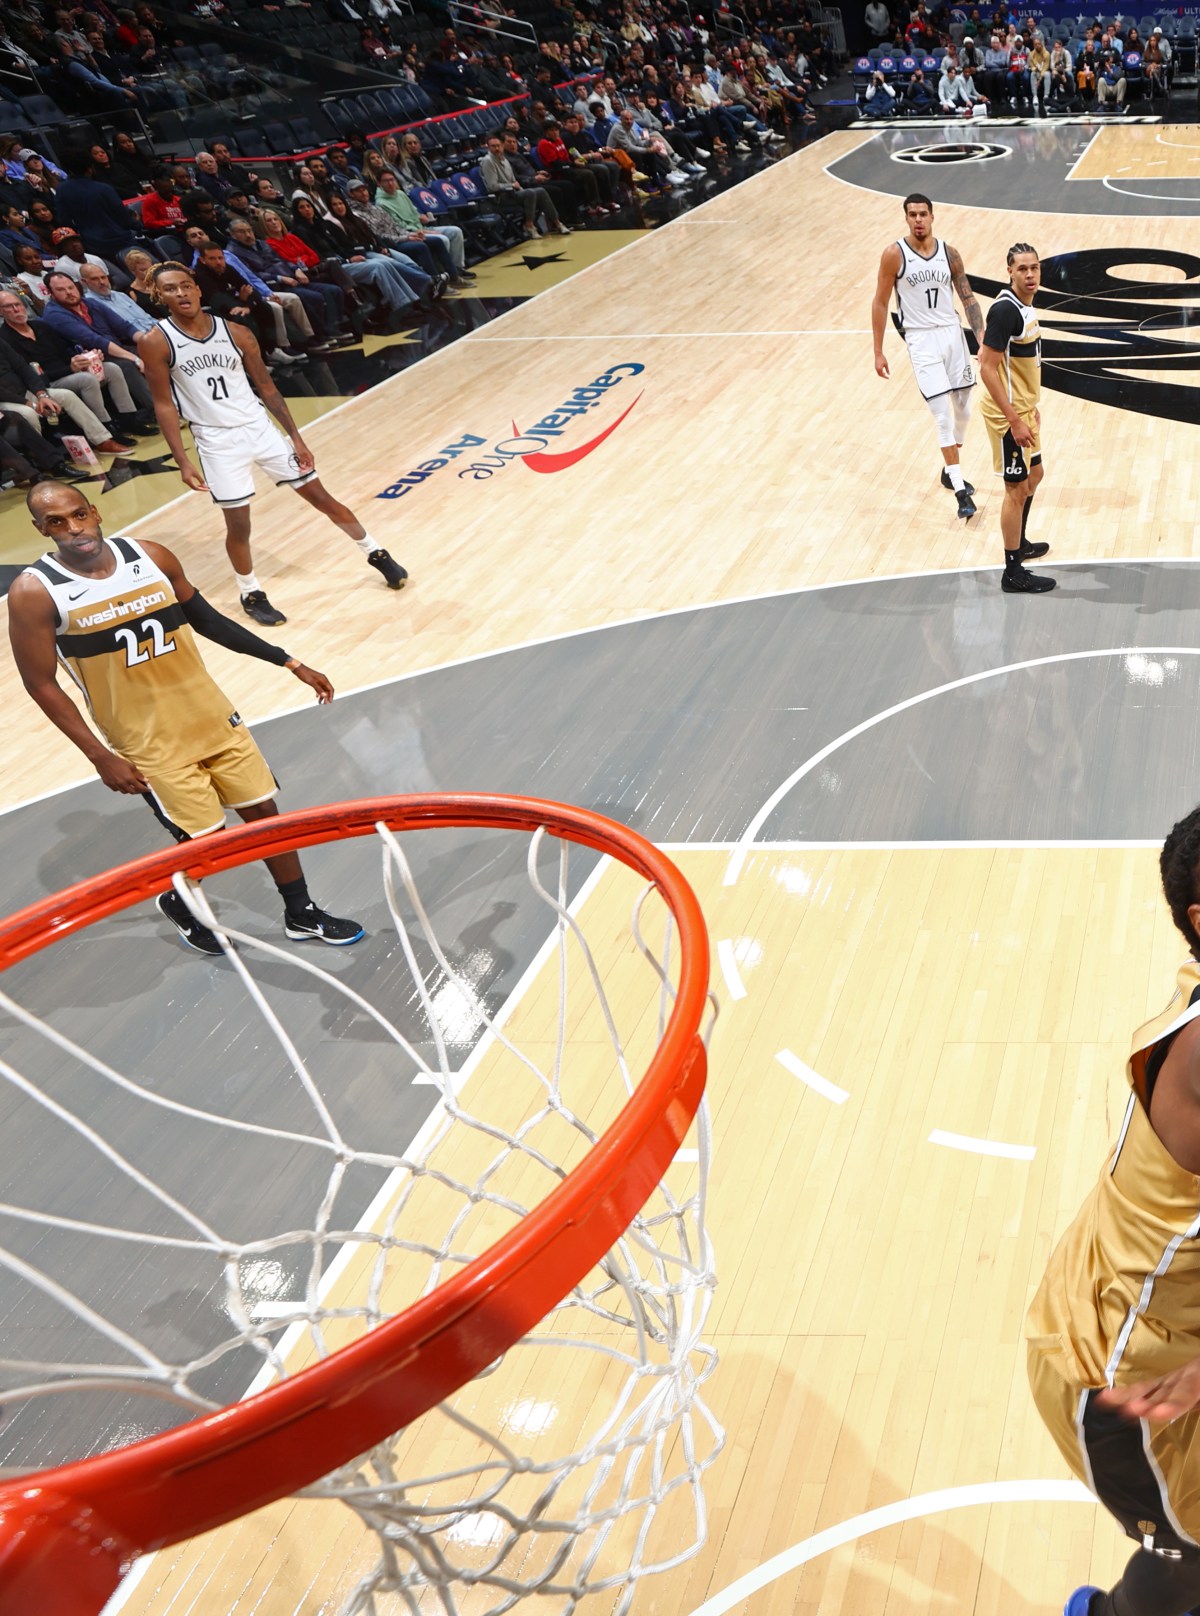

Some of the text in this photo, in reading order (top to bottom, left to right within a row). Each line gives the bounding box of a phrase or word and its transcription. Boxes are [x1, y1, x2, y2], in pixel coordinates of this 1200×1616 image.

[1018, 9, 1043, 17] ULTRA
[906, 269, 951, 289] BROOKLYN
[924, 287, 939, 309] 17
[179, 353, 239, 378] BROOKLYN
[206, 375, 230, 401] 21
[375, 433, 489, 500] Arena
[75, 590, 167, 629] washington
[114, 618, 178, 668] 22
